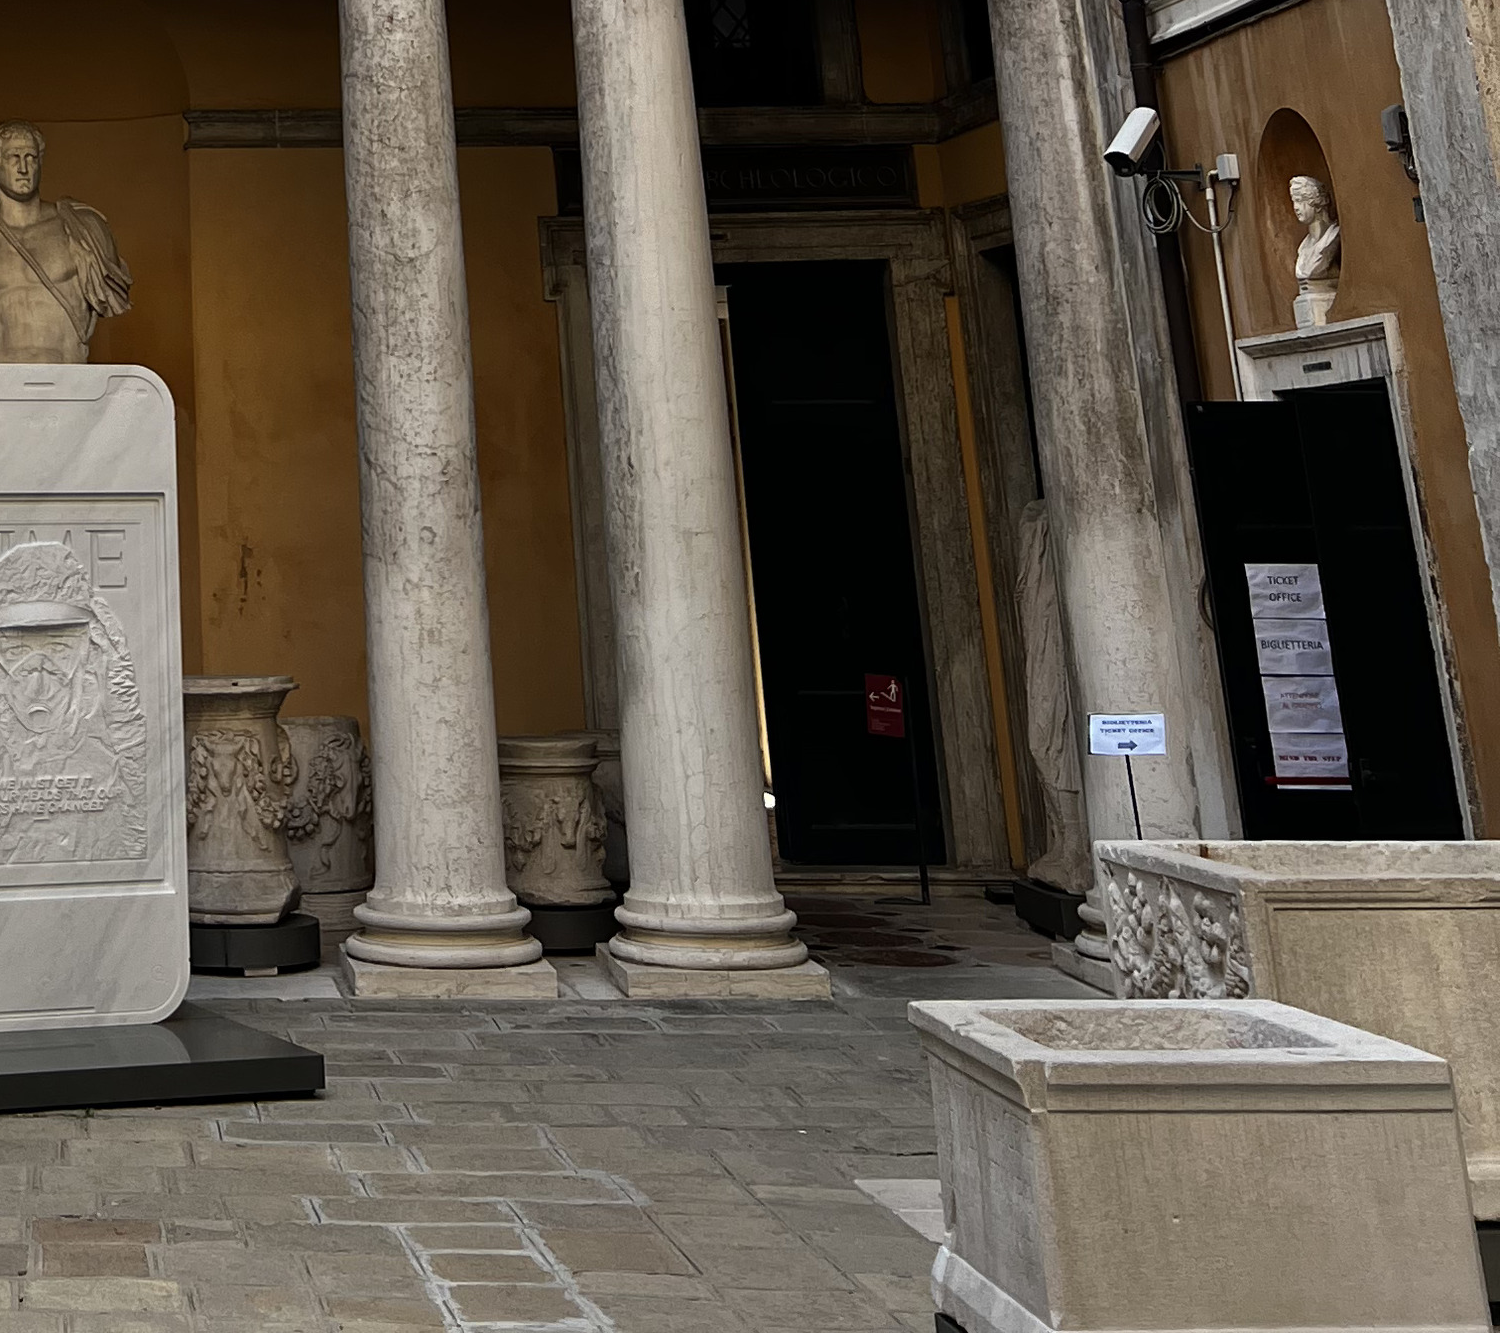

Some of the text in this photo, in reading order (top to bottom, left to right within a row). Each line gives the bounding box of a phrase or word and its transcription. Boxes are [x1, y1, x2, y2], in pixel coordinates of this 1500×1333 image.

[706, 165, 897, 190] RCHEOLOGICO
[1267, 575, 1299, 585] TICKET
[1269, 592, 1302, 602] OFFICE
[1260, 639, 1325, 650] BIGLIETTERIA
